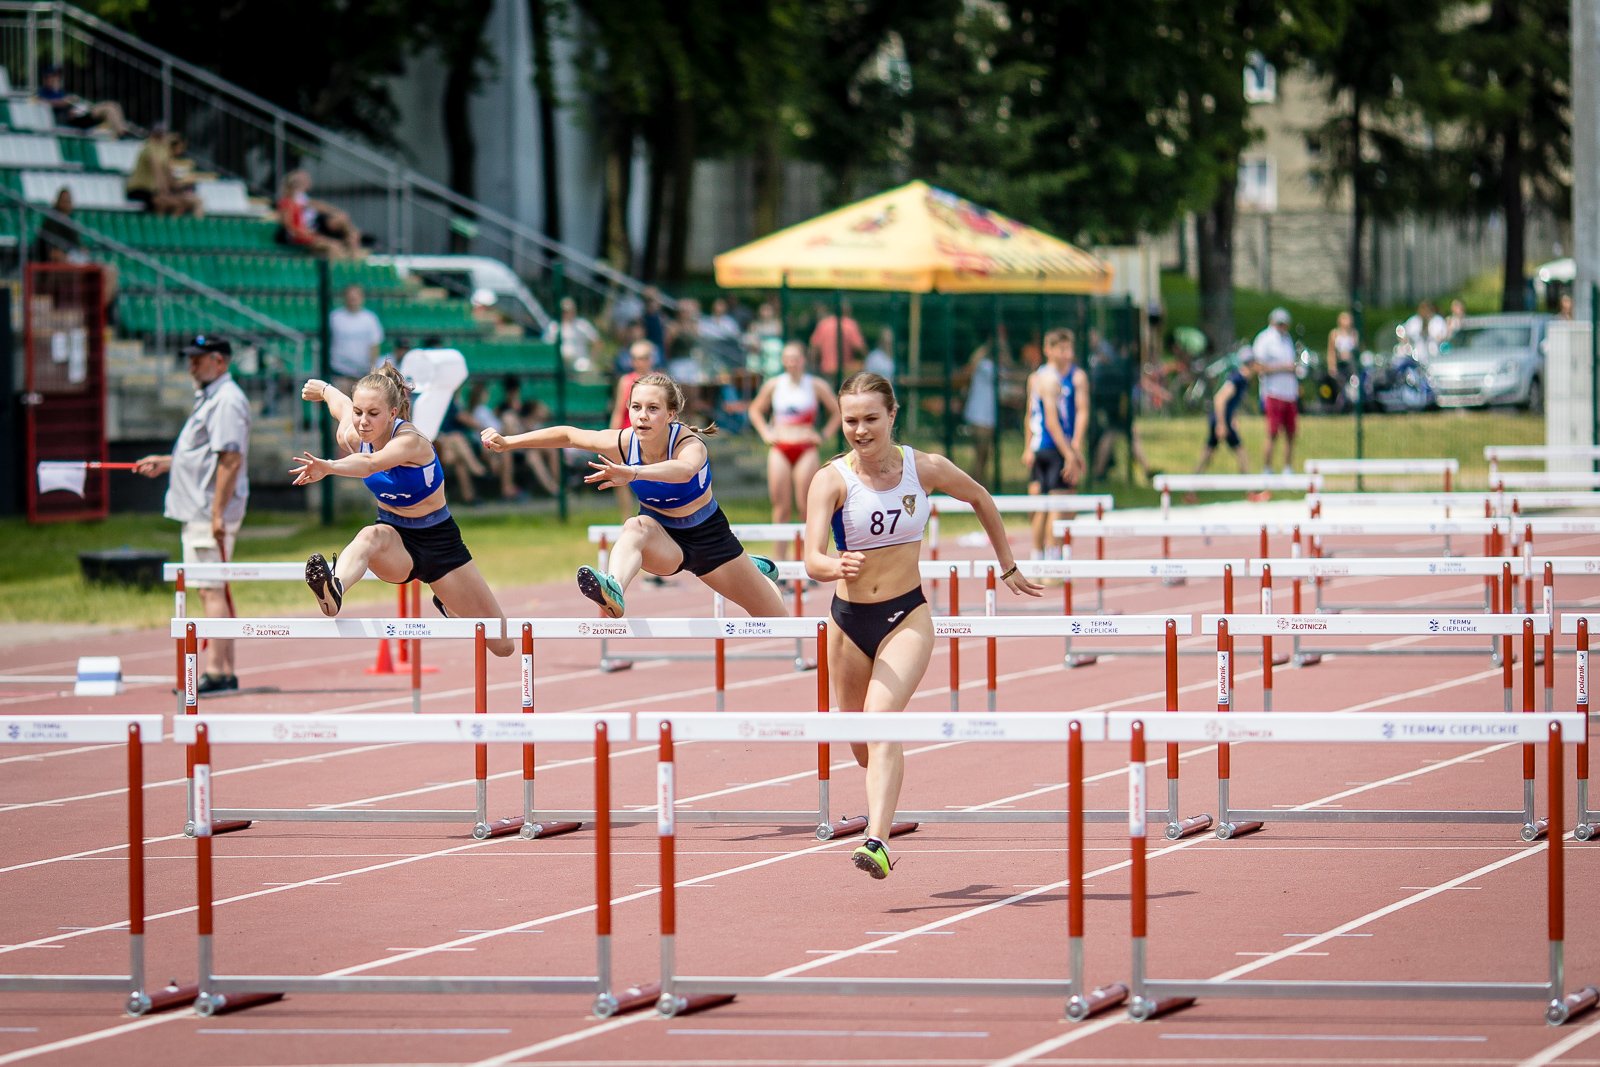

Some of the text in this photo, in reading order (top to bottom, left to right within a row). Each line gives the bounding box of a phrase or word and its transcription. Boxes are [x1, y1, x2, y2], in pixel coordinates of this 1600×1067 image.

[870, 509, 902, 536] 87
[1220, 665, 1228, 695] polanik
[1578, 665, 1586, 694] polanik
[1403, 724, 1520, 735] TERMY CIEPLICKIE
